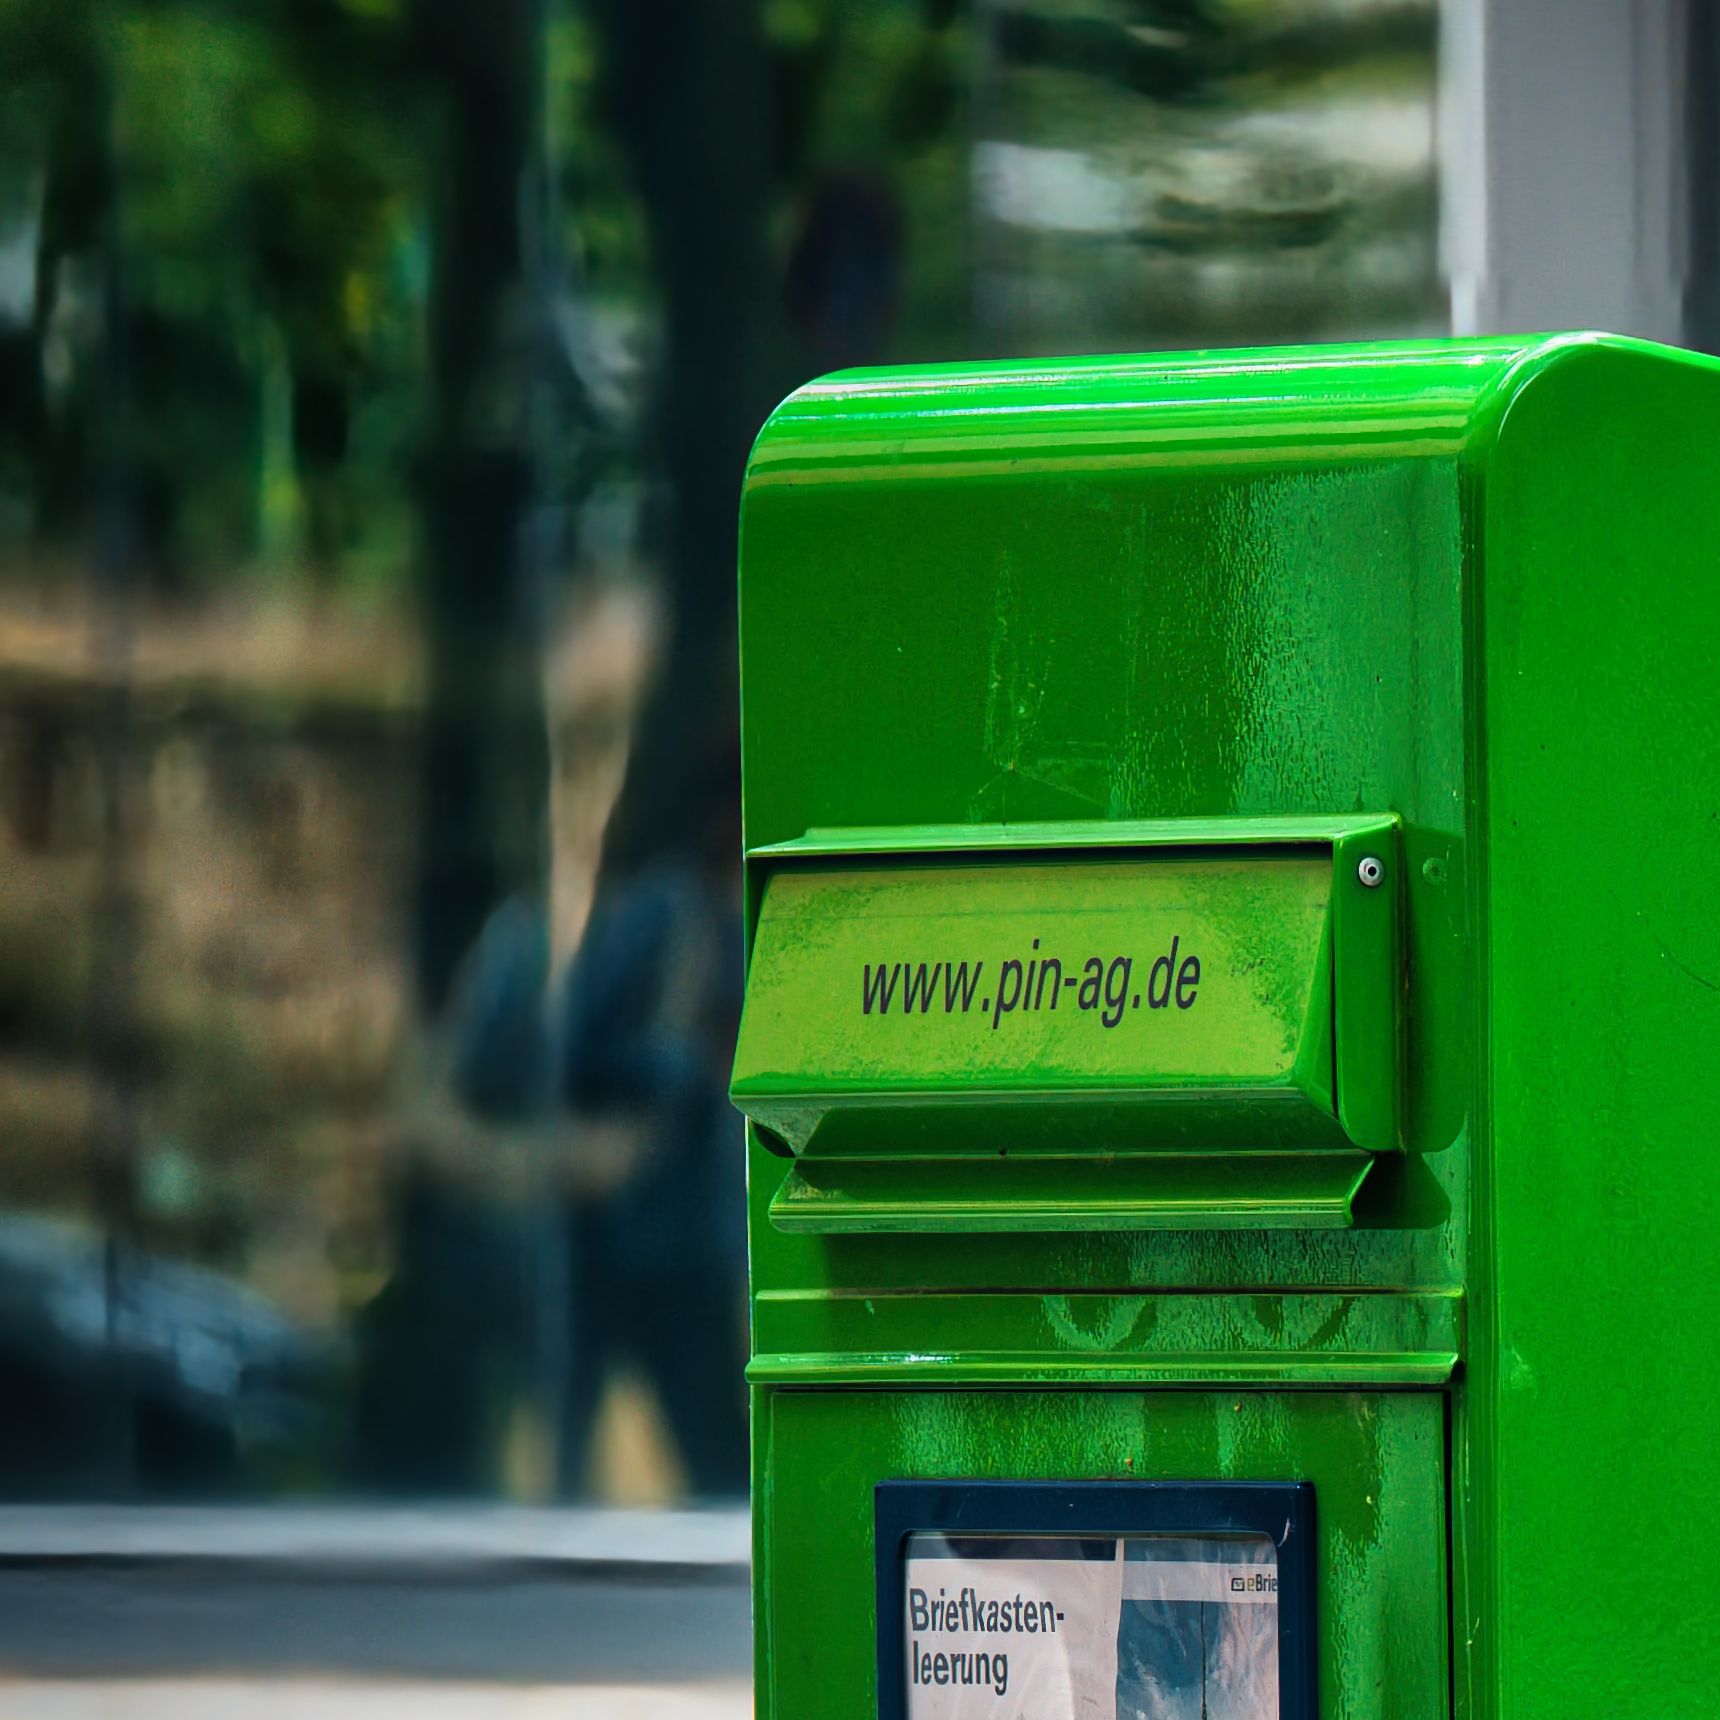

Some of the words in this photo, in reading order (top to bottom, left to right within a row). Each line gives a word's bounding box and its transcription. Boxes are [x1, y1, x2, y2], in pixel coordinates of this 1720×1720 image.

[862, 936, 1202, 1028] www.pin-ag.de
[909, 1588, 1065, 1633] Briefkasten-
[912, 1641, 1008, 1696] leerung
